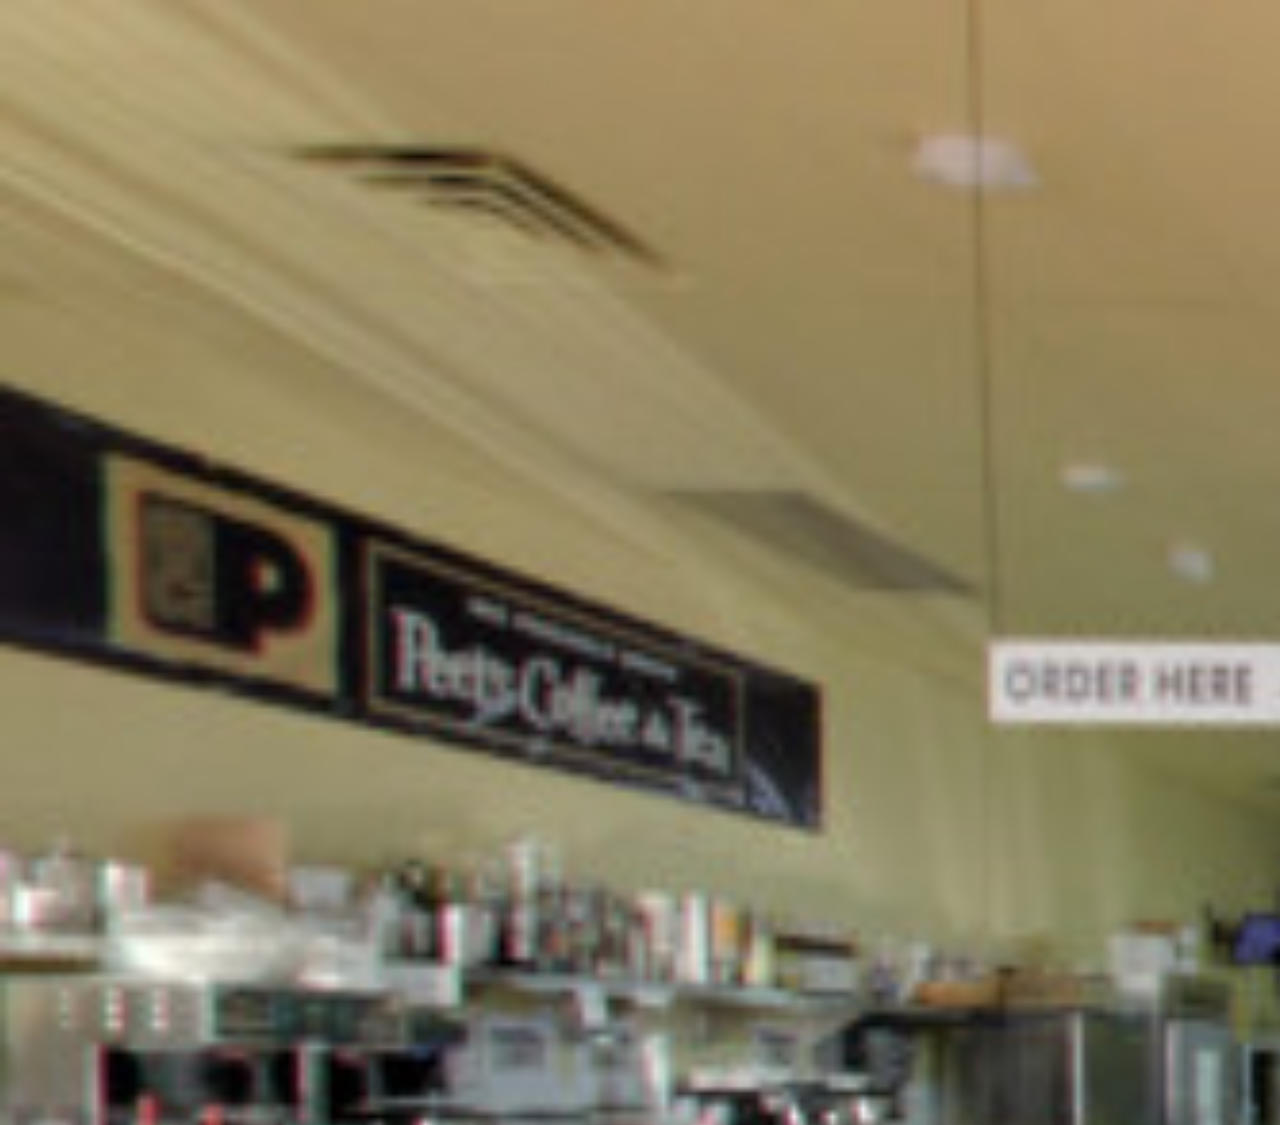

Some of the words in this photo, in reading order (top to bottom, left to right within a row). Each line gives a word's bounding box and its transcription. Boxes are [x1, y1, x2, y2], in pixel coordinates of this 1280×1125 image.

[516, 652, 639, 743] Coffee
[667, 693, 734, 776] Tea
[1005, 661, 1140, 705] ORDER
[1154, 662, 1254, 705] HERE
